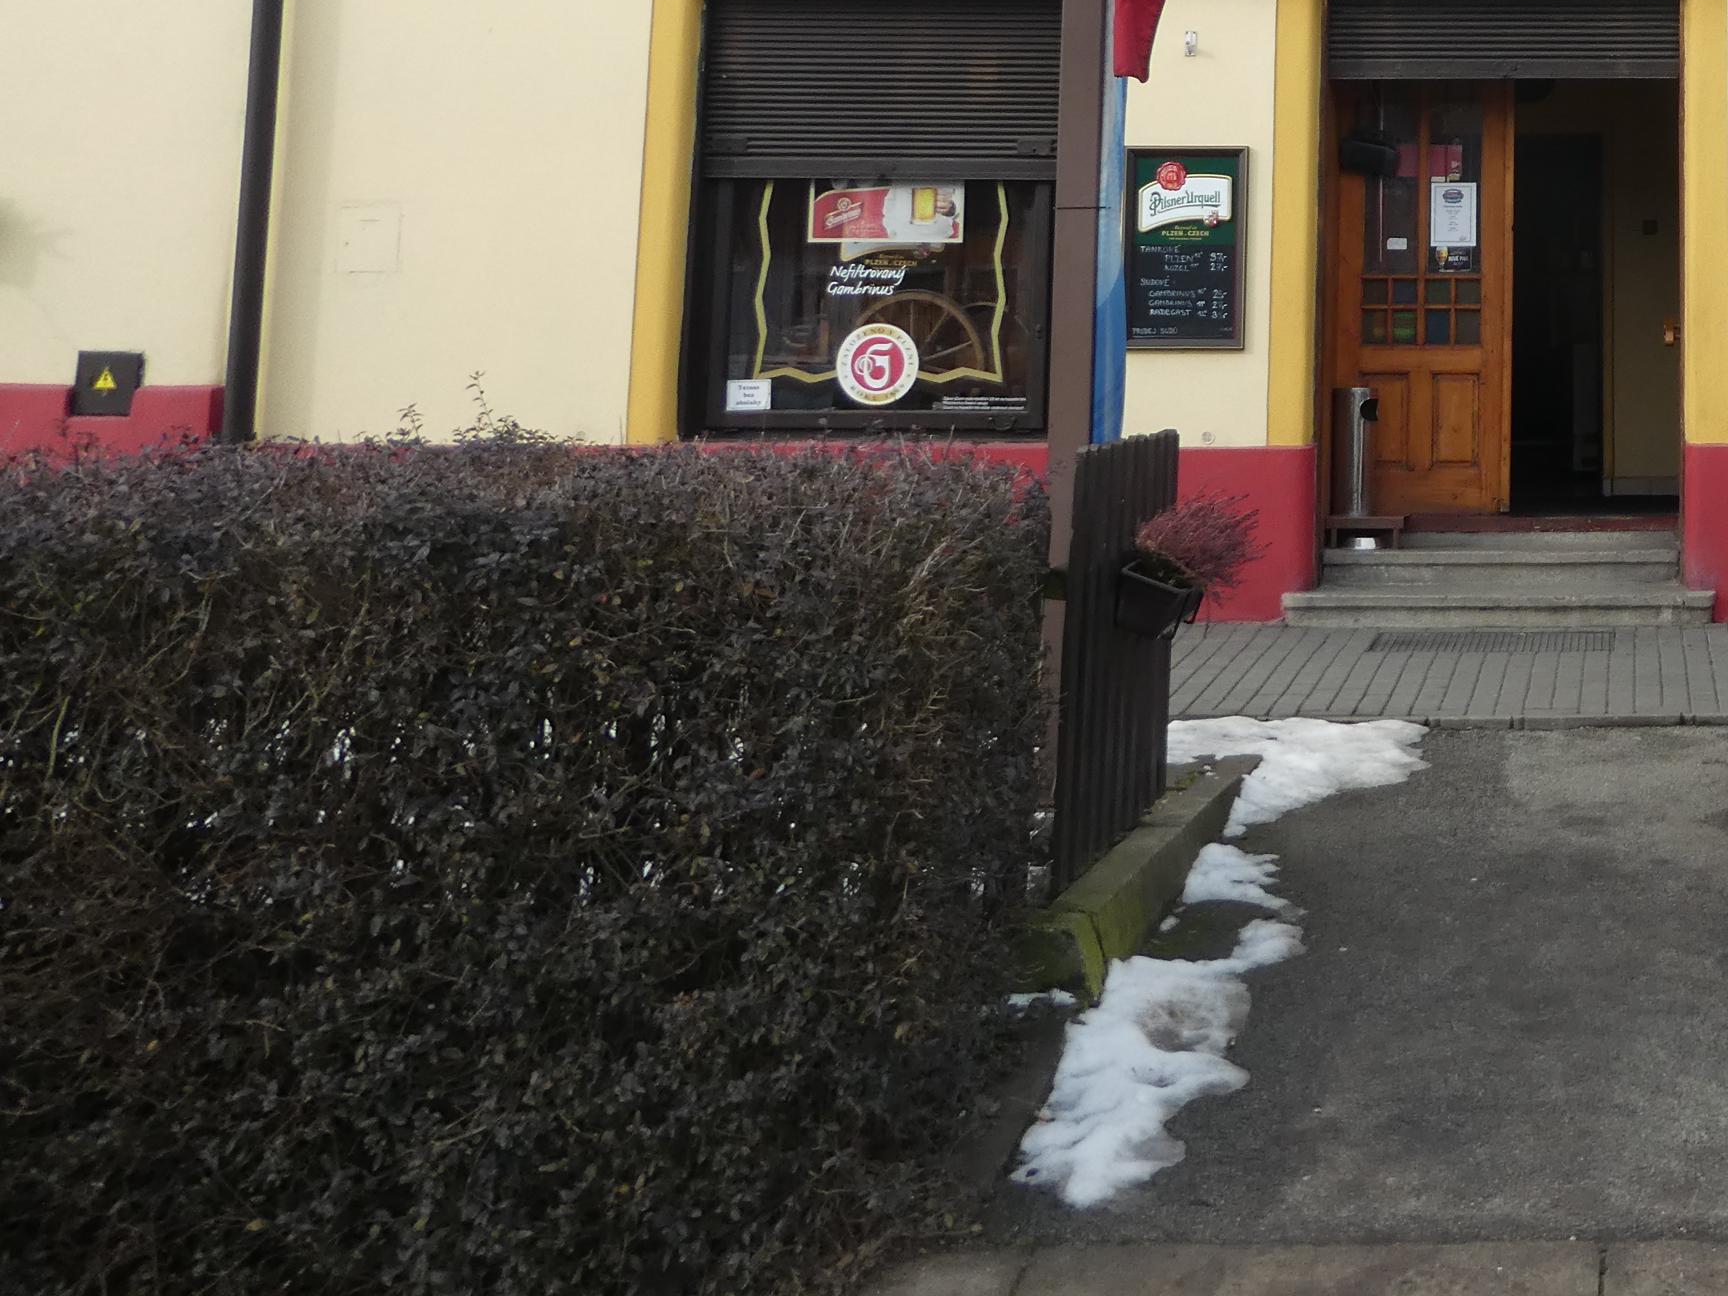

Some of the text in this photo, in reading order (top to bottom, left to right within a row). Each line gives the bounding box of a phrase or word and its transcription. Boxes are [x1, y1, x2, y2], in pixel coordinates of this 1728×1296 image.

[1148, 190, 1221, 217] Pilsner Urquell
[829, 263, 907, 286] Nefiltrovaný
[826, 281, 895, 296] Gambrinus
